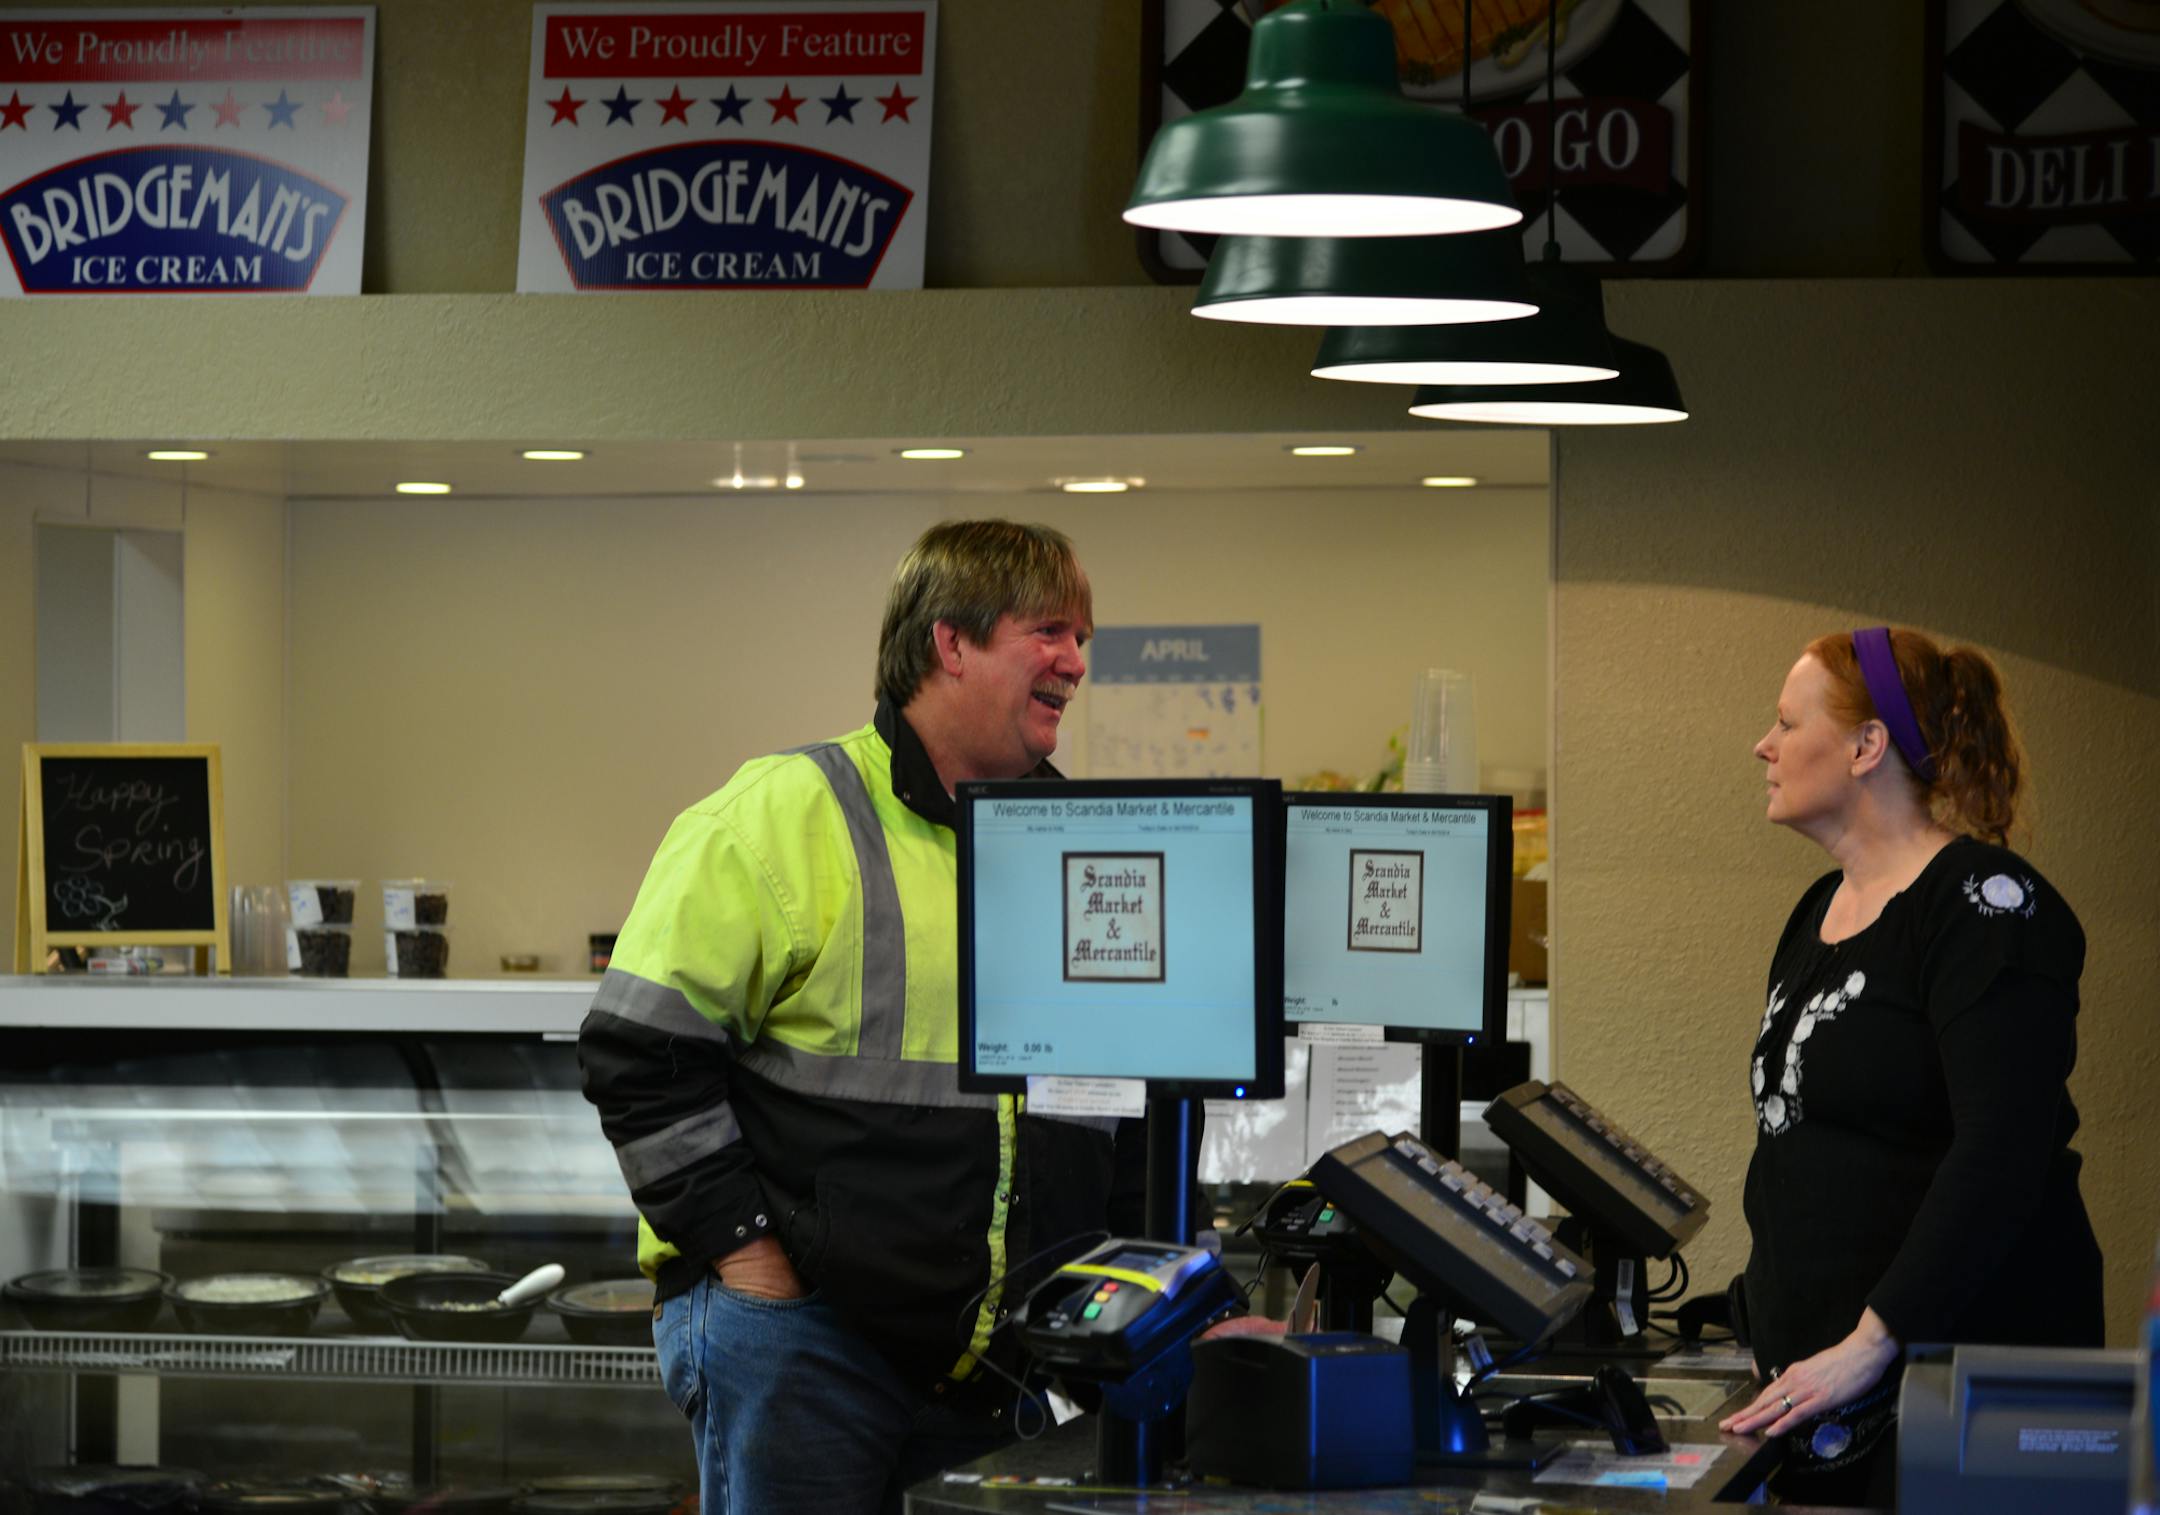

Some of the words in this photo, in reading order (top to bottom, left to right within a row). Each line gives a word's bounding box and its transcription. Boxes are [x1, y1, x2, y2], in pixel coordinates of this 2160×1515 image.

[10, 32, 63, 65] We
[75, 31, 209, 72] Proudly
[224, 31, 353, 65] Feature
[561, 27, 615, 60] We
[629, 26, 766, 67] Proudly
[780, 24, 911, 58] Feature
[1480, 116, 1533, 179] O
[1552, 108, 1640, 171] GO
[1984, 140, 2129, 208] DELI
[10, 164, 328, 265] BRIDGEMAN'S
[562, 160, 890, 260] BRIDGEMAN'S
[72, 256, 127, 284] ICE
[136, 256, 262, 284] CREAM
[626, 252, 681, 280] ICE
[691, 252, 821, 280] CREAM
[1140, 639, 1209, 662] APRIL
[52, 772, 180, 835] Happy
[993, 802, 1047, 817] Welcome
[1051, 802, 1062, 817] to
[1066, 801, 1113, 817] Scandia
[1117, 801, 1158, 817] Market
[1161, 801, 1169, 816] &
[1174, 801, 1234, 816] Mercantile
[1301, 809, 1341, 822] Welcome
[1344, 810, 1352, 822] to
[1354, 810, 1388, 823] Scandia
[1391, 811, 1420, 823] Market
[1423, 812, 1429, 823] &
[1431, 811, 1476, 825] Mercantile
[1081, 865, 1146, 892] Scandia
[1362, 860, 1411, 881] Scandia
[1084, 892, 1143, 920] Market
[1365, 881, 1408, 904] Market
[1380, 903, 1391, 919] &
[1106, 918, 1121, 940] &
[1354, 918, 1416, 940] Mercantile
[1072, 938, 1157, 968] Mercantile
